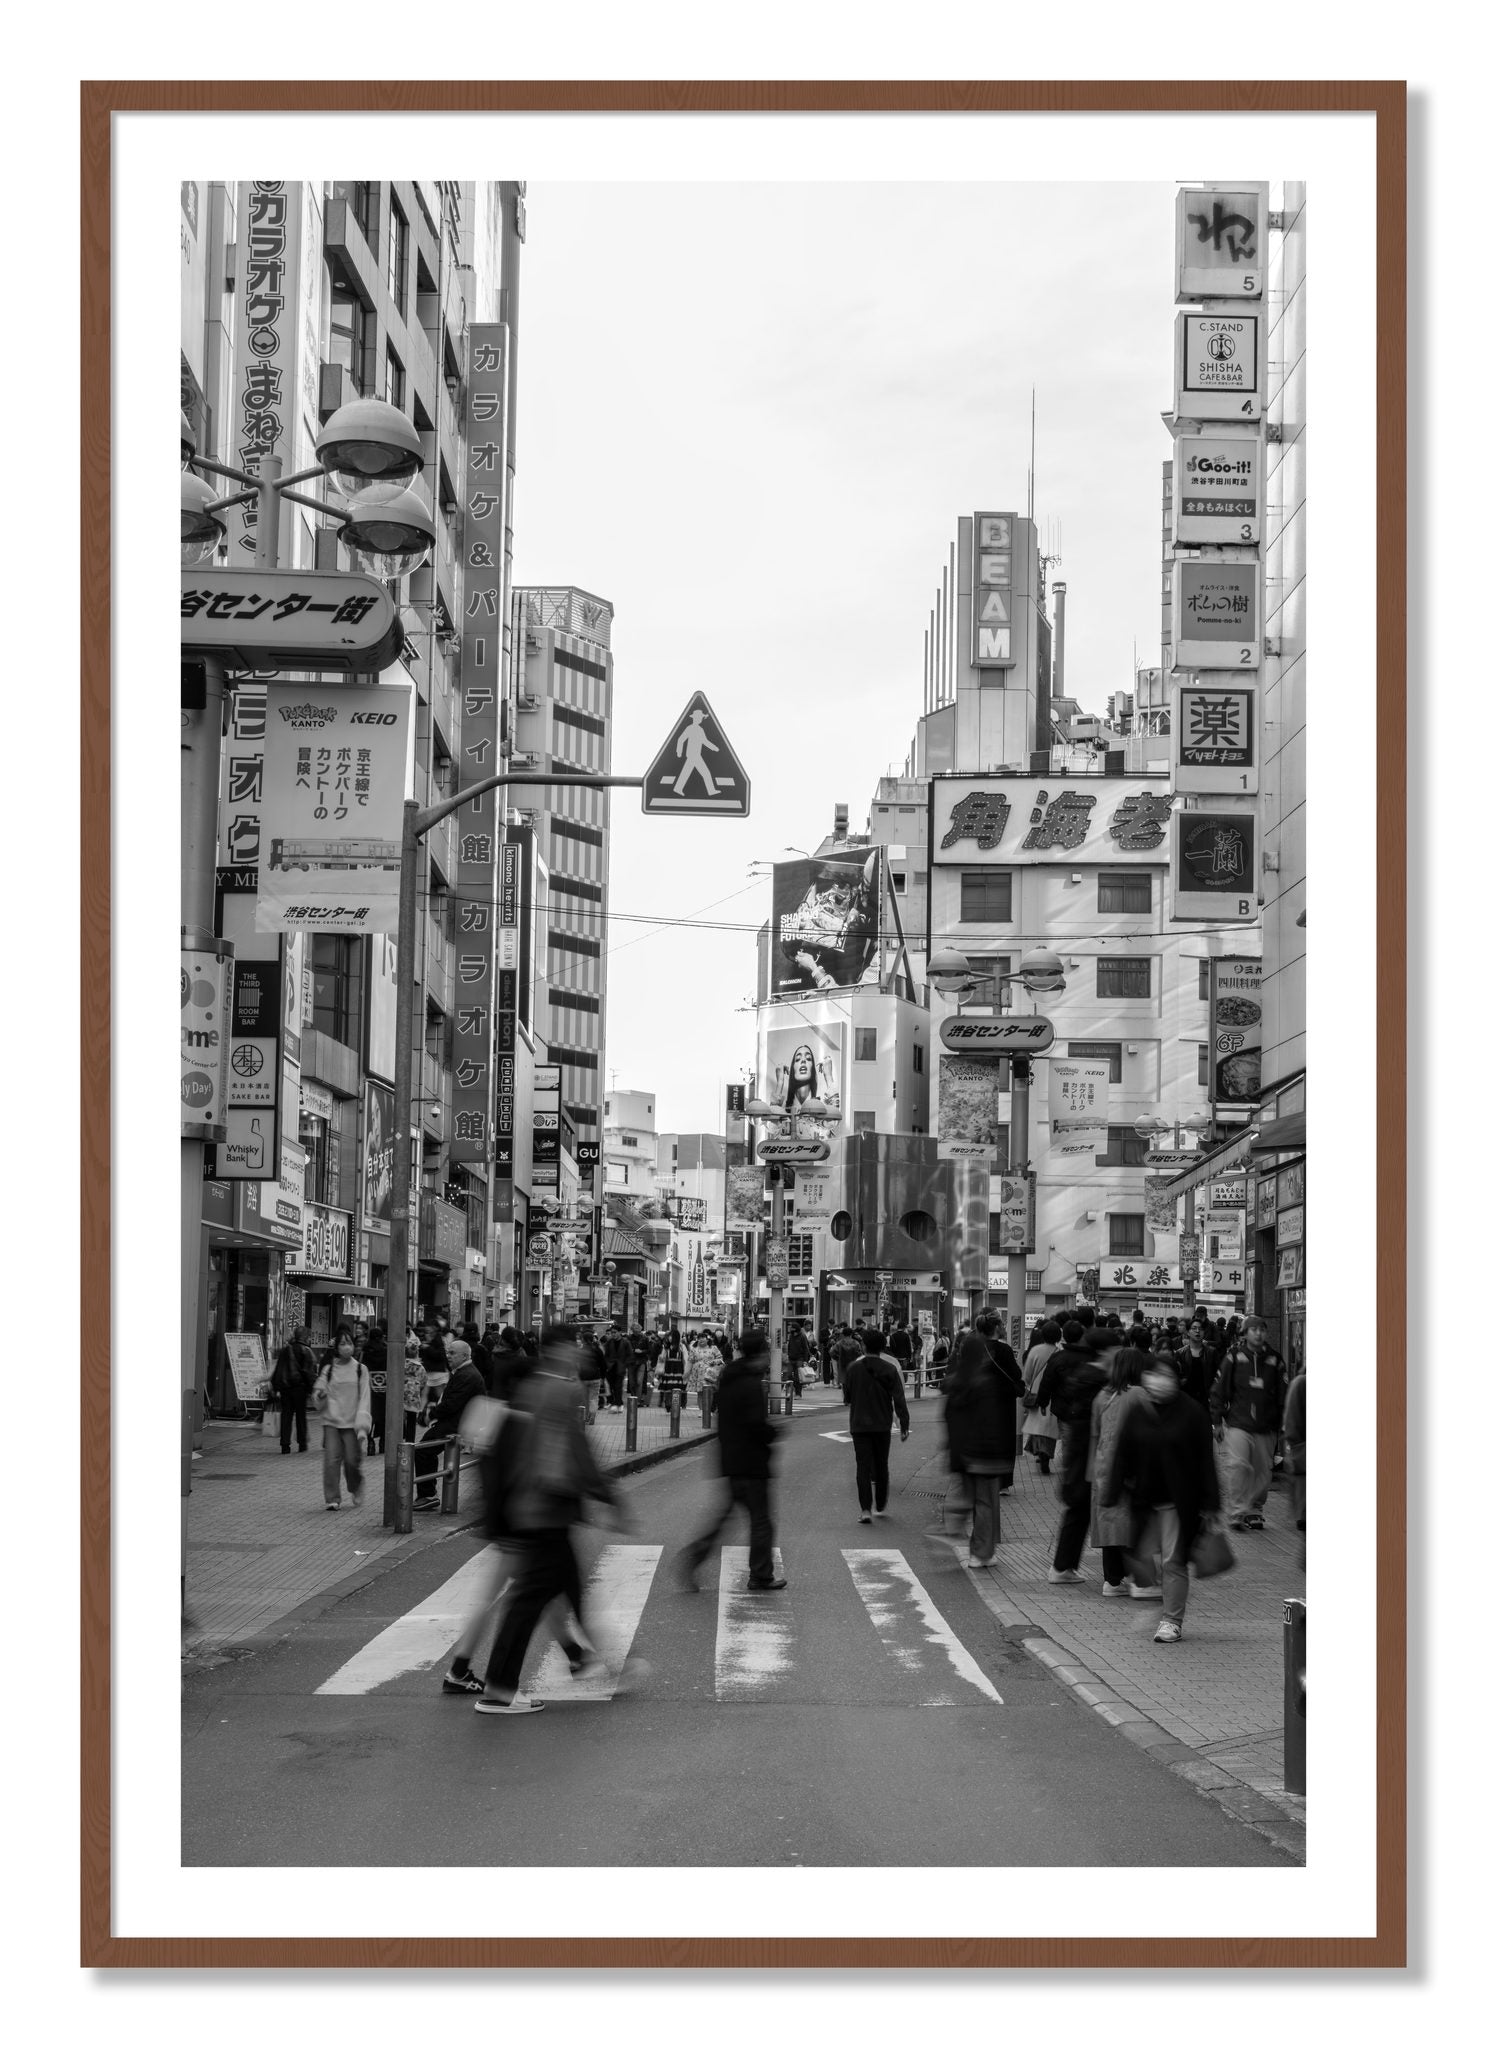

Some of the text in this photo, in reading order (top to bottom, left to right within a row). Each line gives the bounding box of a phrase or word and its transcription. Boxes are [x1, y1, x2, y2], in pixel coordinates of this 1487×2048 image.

[247, 193, 287, 328] カラオケ
[1243, 276, 1255, 292] 5
[1199, 323, 1244, 333] C.STAND
[1199, 362, 1244, 374] SHISHA
[1241, 400, 1254, 415] 4
[1197, 457, 1251, 474] Goo-it!
[1191, 476, 1249, 487] 渋谷宇田川町店
[1185, 502, 1252, 513] 全身もみほぐし
[1240, 524, 1252, 541] 3
[979, 516, 1012, 660] BEAM
[1240, 648, 1252, 664] 2
[291, 719, 325, 728] KANTO
[350, 712, 398, 726] KEIO
[1190, 696, 1240, 746] 薬
[227, 668, 273, 866] ラオケ
[295, 746, 312, 789] 冒険へ
[314, 747, 331, 820] カントーの
[334, 747, 351, 820] ポケパーク
[354, 748, 371, 806] 京王線で
[1239, 774, 1248, 790] 1
[941, 790, 1177, 850] 角海老
[1184, 828, 1244, 876] 一蘭
[504, 848, 513, 922] kimono hearts
[283, 906, 370, 919] 渋谷センター街
[1238, 899, 1250, 915] B
[241, 1018, 256, 1026] BAR
[456, 903, 492, 1141] カラオケ館
[946, 1024, 1048, 1038] 渋谷センター街
[1216, 1033, 1245, 1053] 6F
[192, 1081, 212, 1095] Day!
[226, 1144, 259, 1156] Whisky
[226, 1153, 246, 1162] Bank
[579, 1147, 599, 1159] GU
[695, 1262, 704, 1304] BEER
[692, 1305, 705, 1314] HALL
